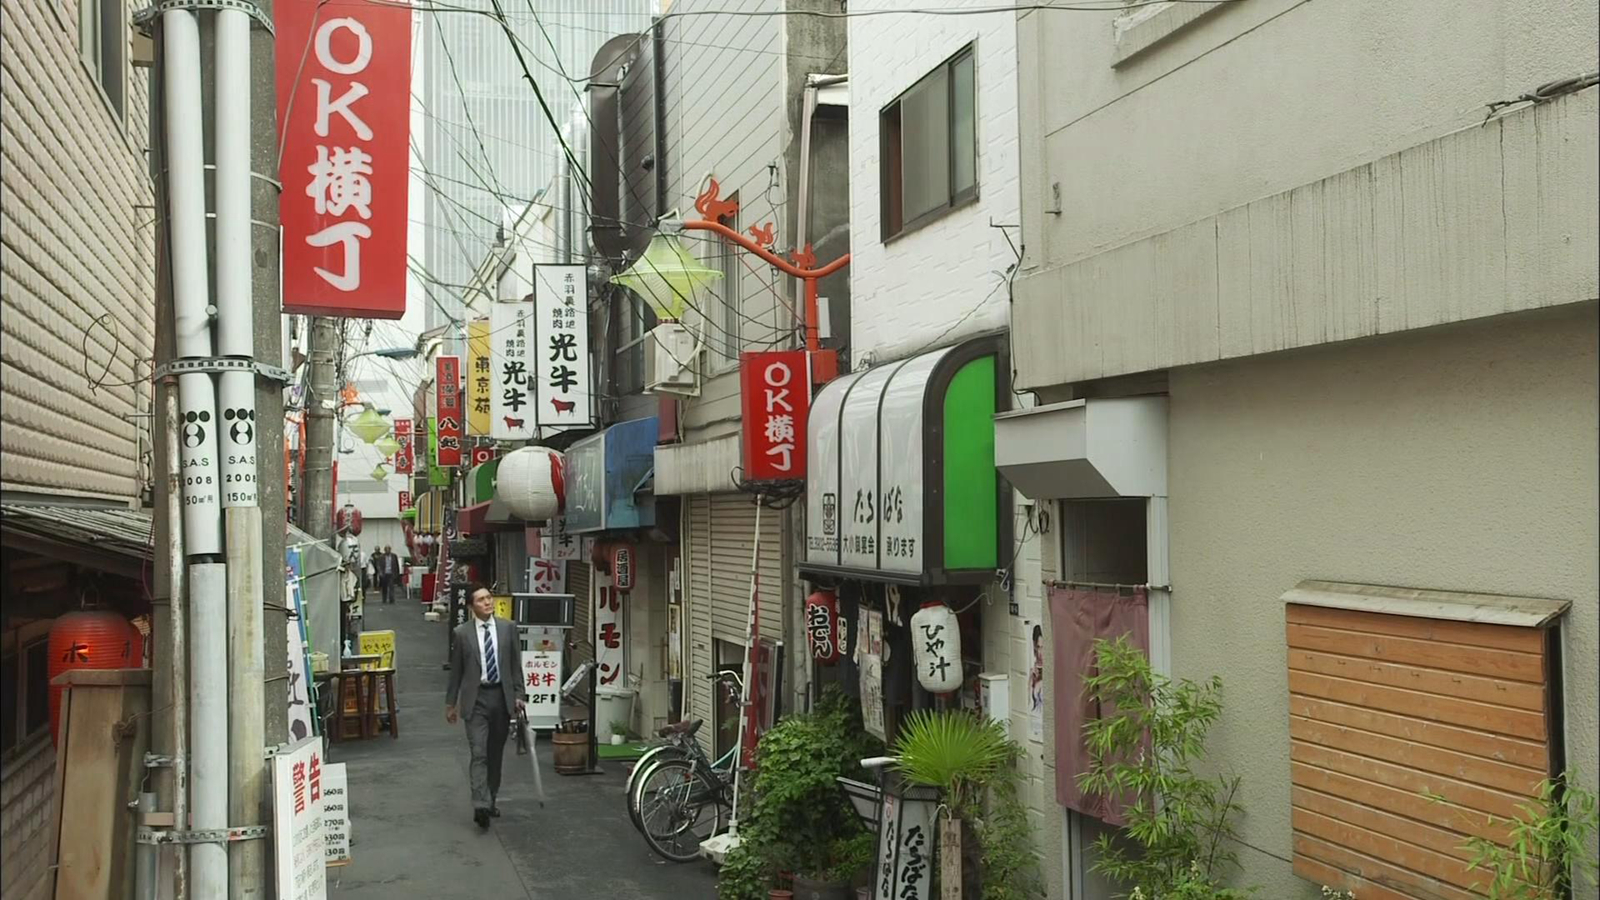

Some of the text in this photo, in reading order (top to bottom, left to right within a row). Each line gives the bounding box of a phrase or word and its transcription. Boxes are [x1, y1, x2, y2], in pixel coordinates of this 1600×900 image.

[305, 17, 373, 291] OK横丁
[475, 356, 490, 413] 東京苑
[503, 361, 526, 411] 光牛
[549, 333, 577, 393] 光牛
[764, 361, 795, 471] OK横丁
[854, 486, 902, 524] たちばな
[525, 660, 557, 669] ホルモン
[920, 624, 951, 681] ひや汁
[526, 672, 556, 687] 光牛
[533, 694, 548, 704] 2F
